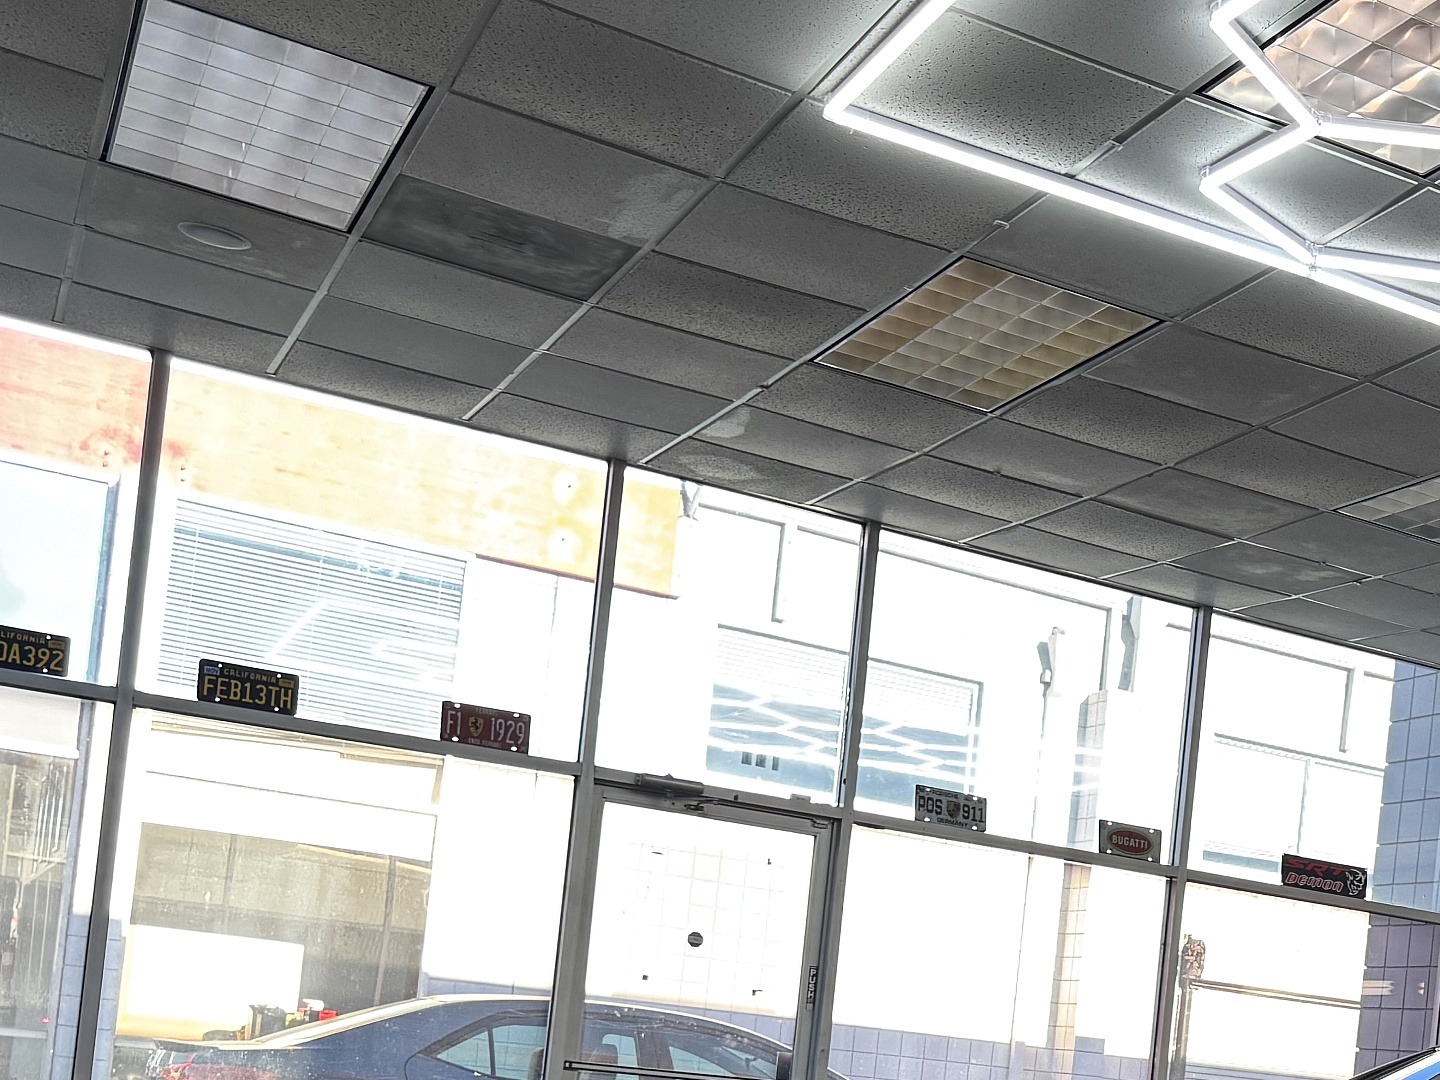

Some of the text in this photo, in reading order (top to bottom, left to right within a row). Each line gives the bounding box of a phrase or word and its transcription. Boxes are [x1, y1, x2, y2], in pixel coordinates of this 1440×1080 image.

[223, 668, 277, 684] CALIFORNIA
[203, 675, 293, 710] FEB13TH
[446, 710, 525, 745] F1 1929
[962, 803, 985, 823] 911
[1112, 834, 1149, 850] BUGATTI
[807, 968, 817, 999] PUSH
